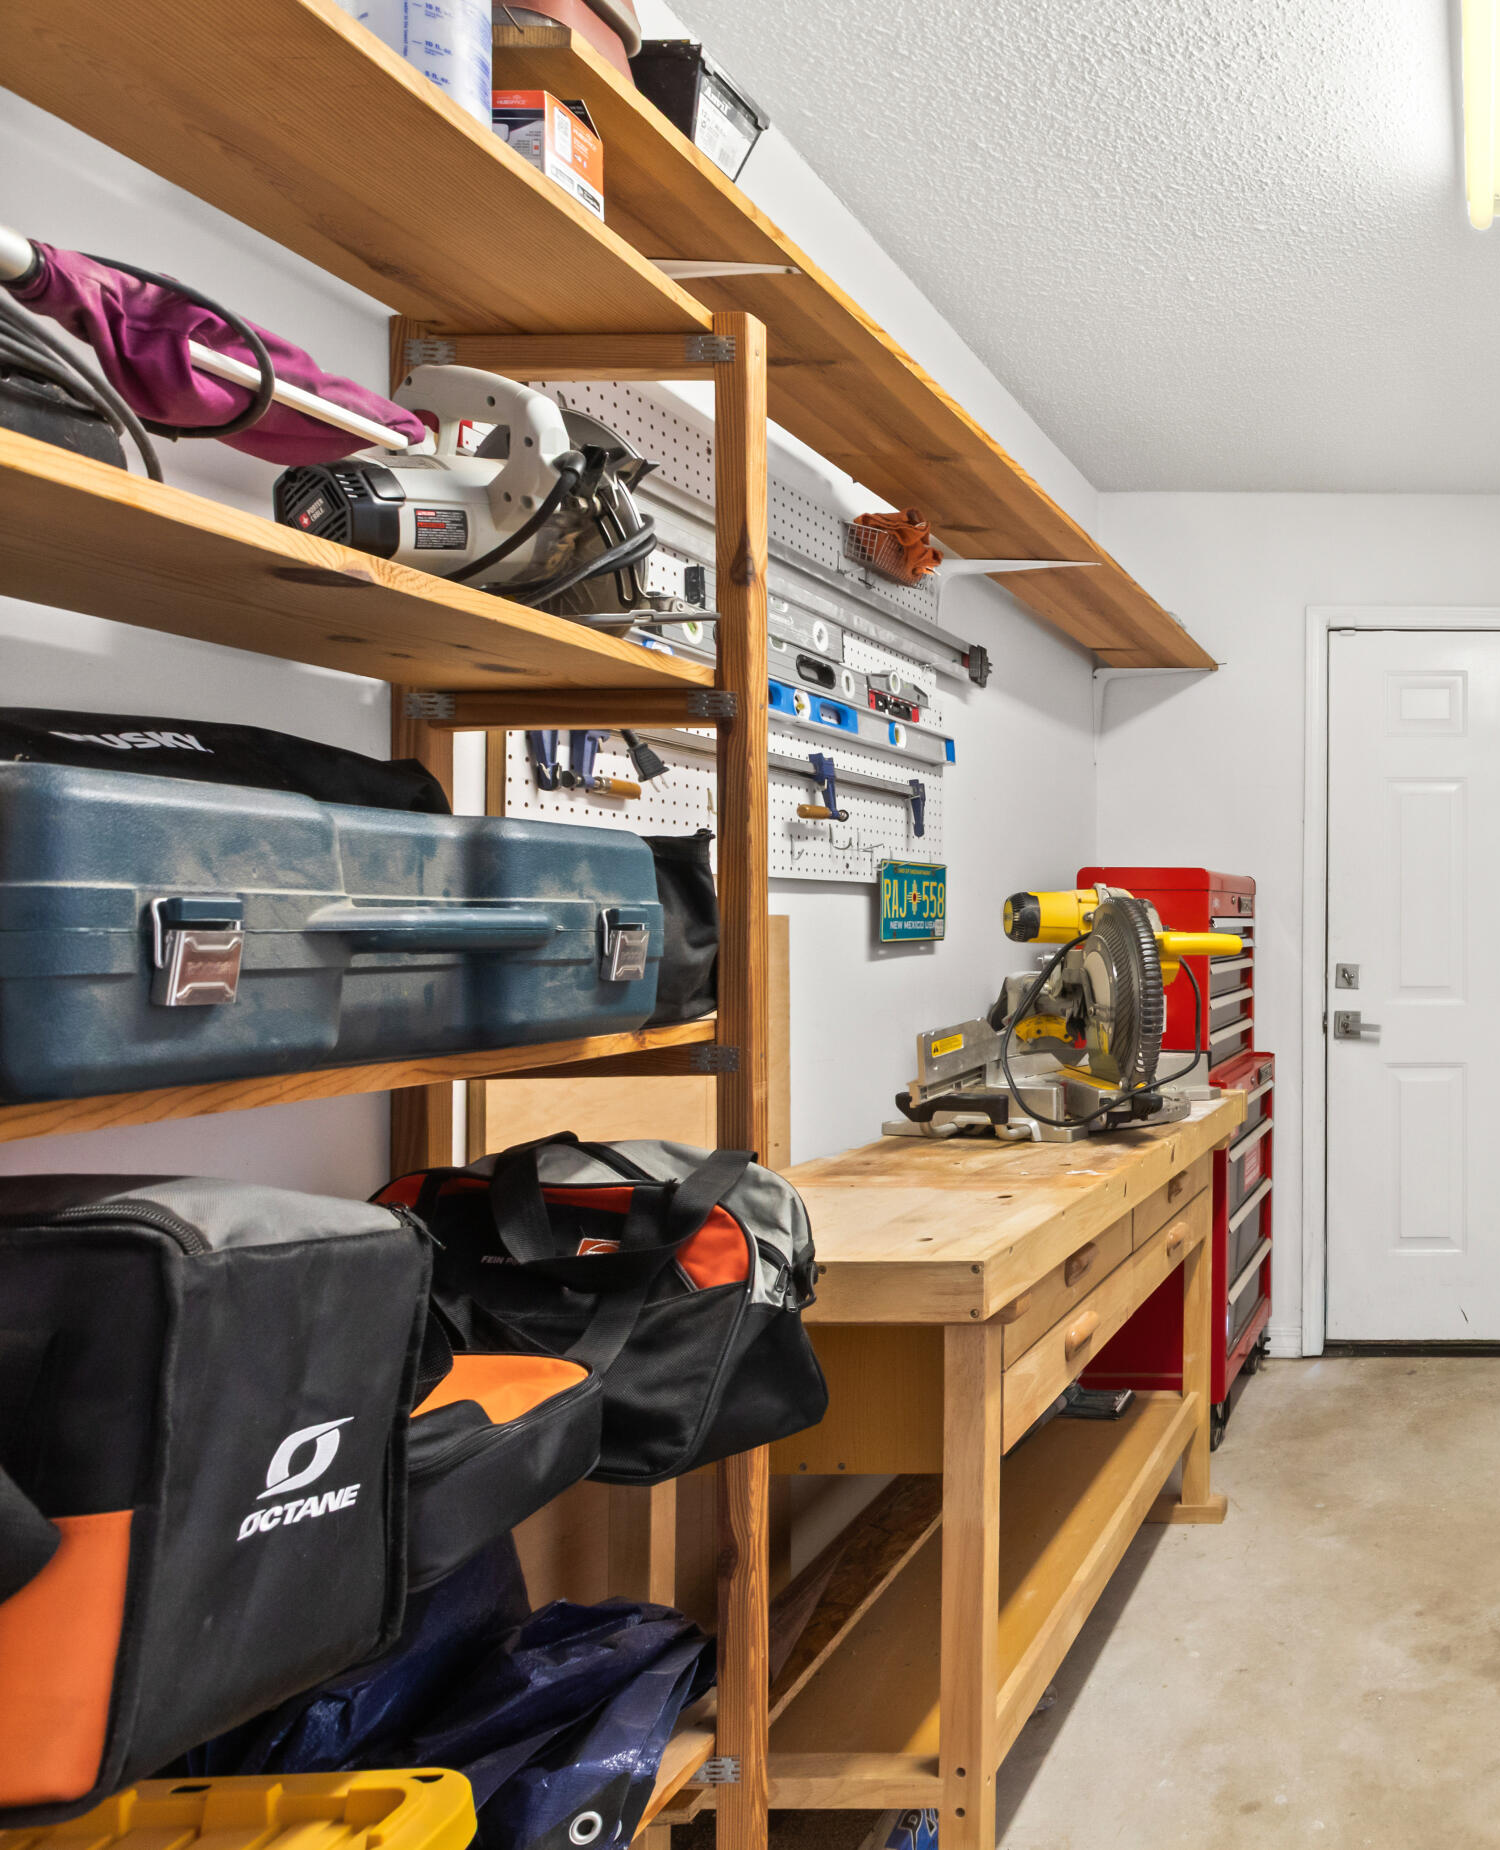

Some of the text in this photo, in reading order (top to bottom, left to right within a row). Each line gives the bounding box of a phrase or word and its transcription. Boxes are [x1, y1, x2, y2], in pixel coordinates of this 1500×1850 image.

[884, 878, 945, 919] RAJ 558
[889, 920, 903, 929] NEW
[904, 920, 924, 929] MEXICO
[237, 1483, 361, 1541] OCTANE
